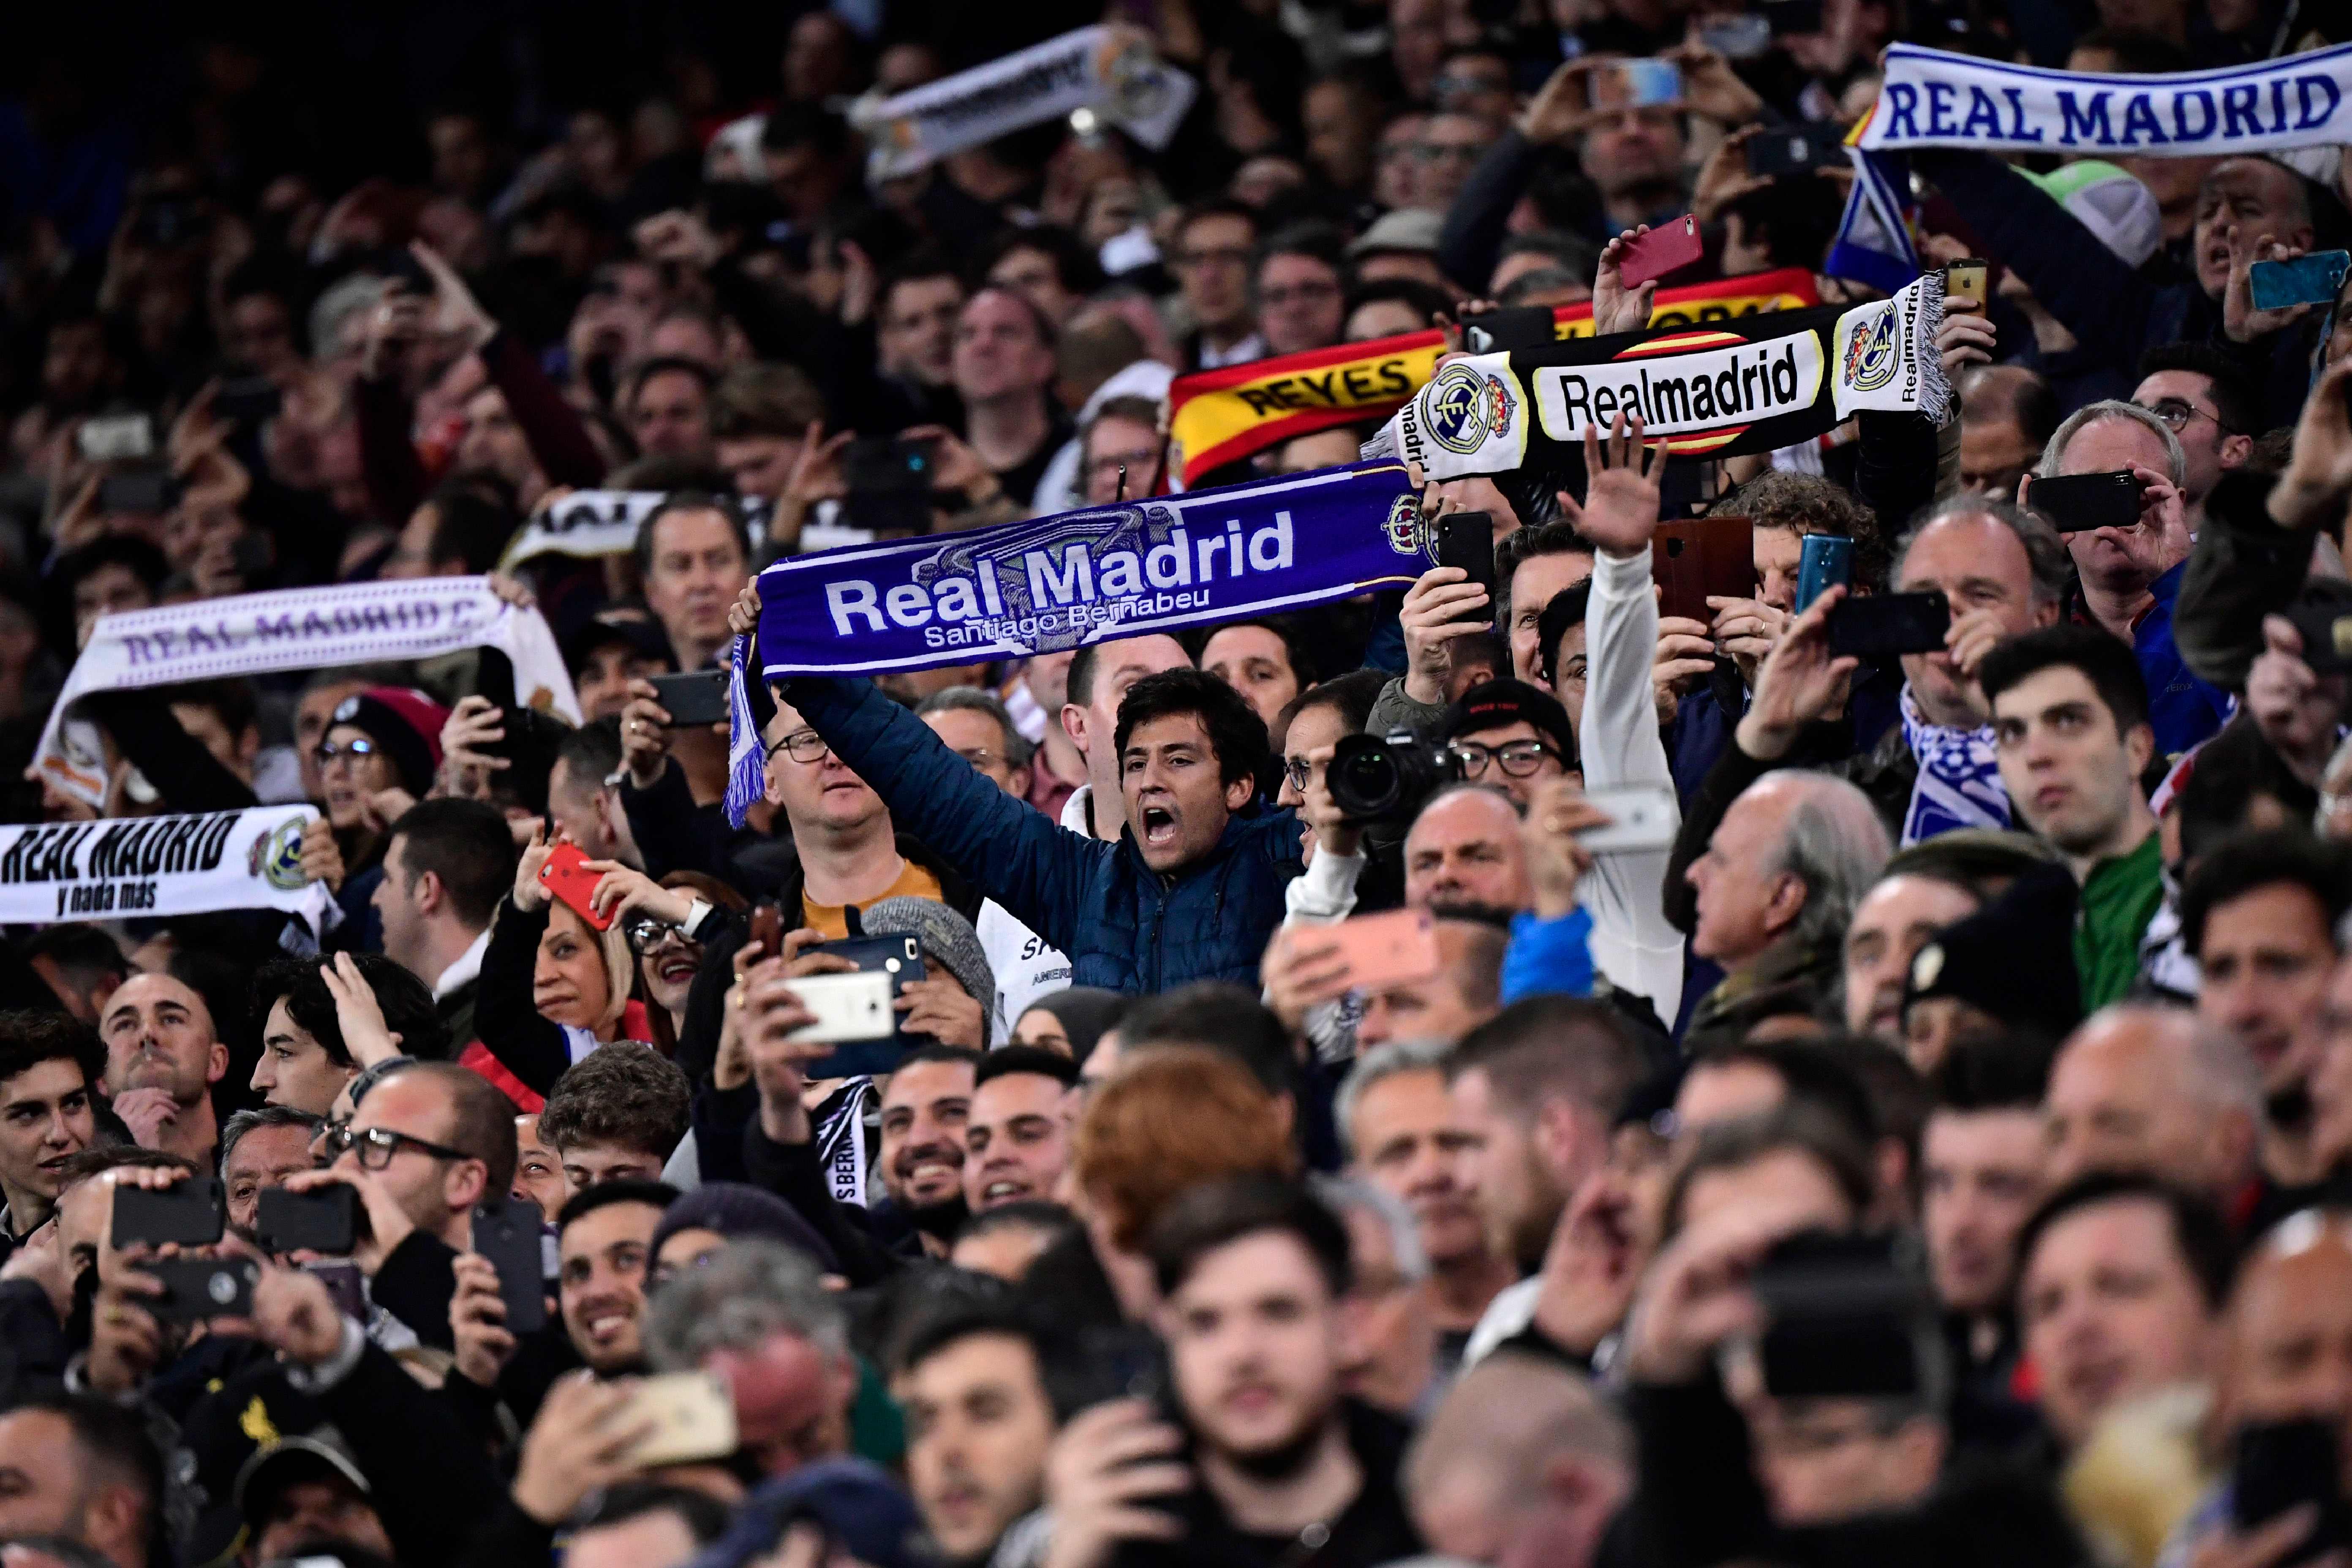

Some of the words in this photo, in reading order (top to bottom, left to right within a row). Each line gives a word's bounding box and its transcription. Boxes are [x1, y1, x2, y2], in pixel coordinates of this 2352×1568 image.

[1883, 82, 2042, 142] REAL
[2055, 74, 2342, 147] MADRID
[1902, 285, 1920, 402] Realmadrid
[1237, 360, 1411, 416] REYES
[1560, 343, 1798, 431] Realmadrid
[825, 559, 1004, 636] Real
[1024, 511, 1294, 609] Madrid
[122, 619, 247, 667] REAL
[255, 599, 439, 642] MADRID
[924, 614, 1058, 648] Santiago
[1068, 589, 1210, 627] Bernabeu
[1, 826, 95, 884] REAL
[88, 814, 242, 879] MADRID
[57, 887, 67, 917] y
[71, 879, 115, 914] nada
